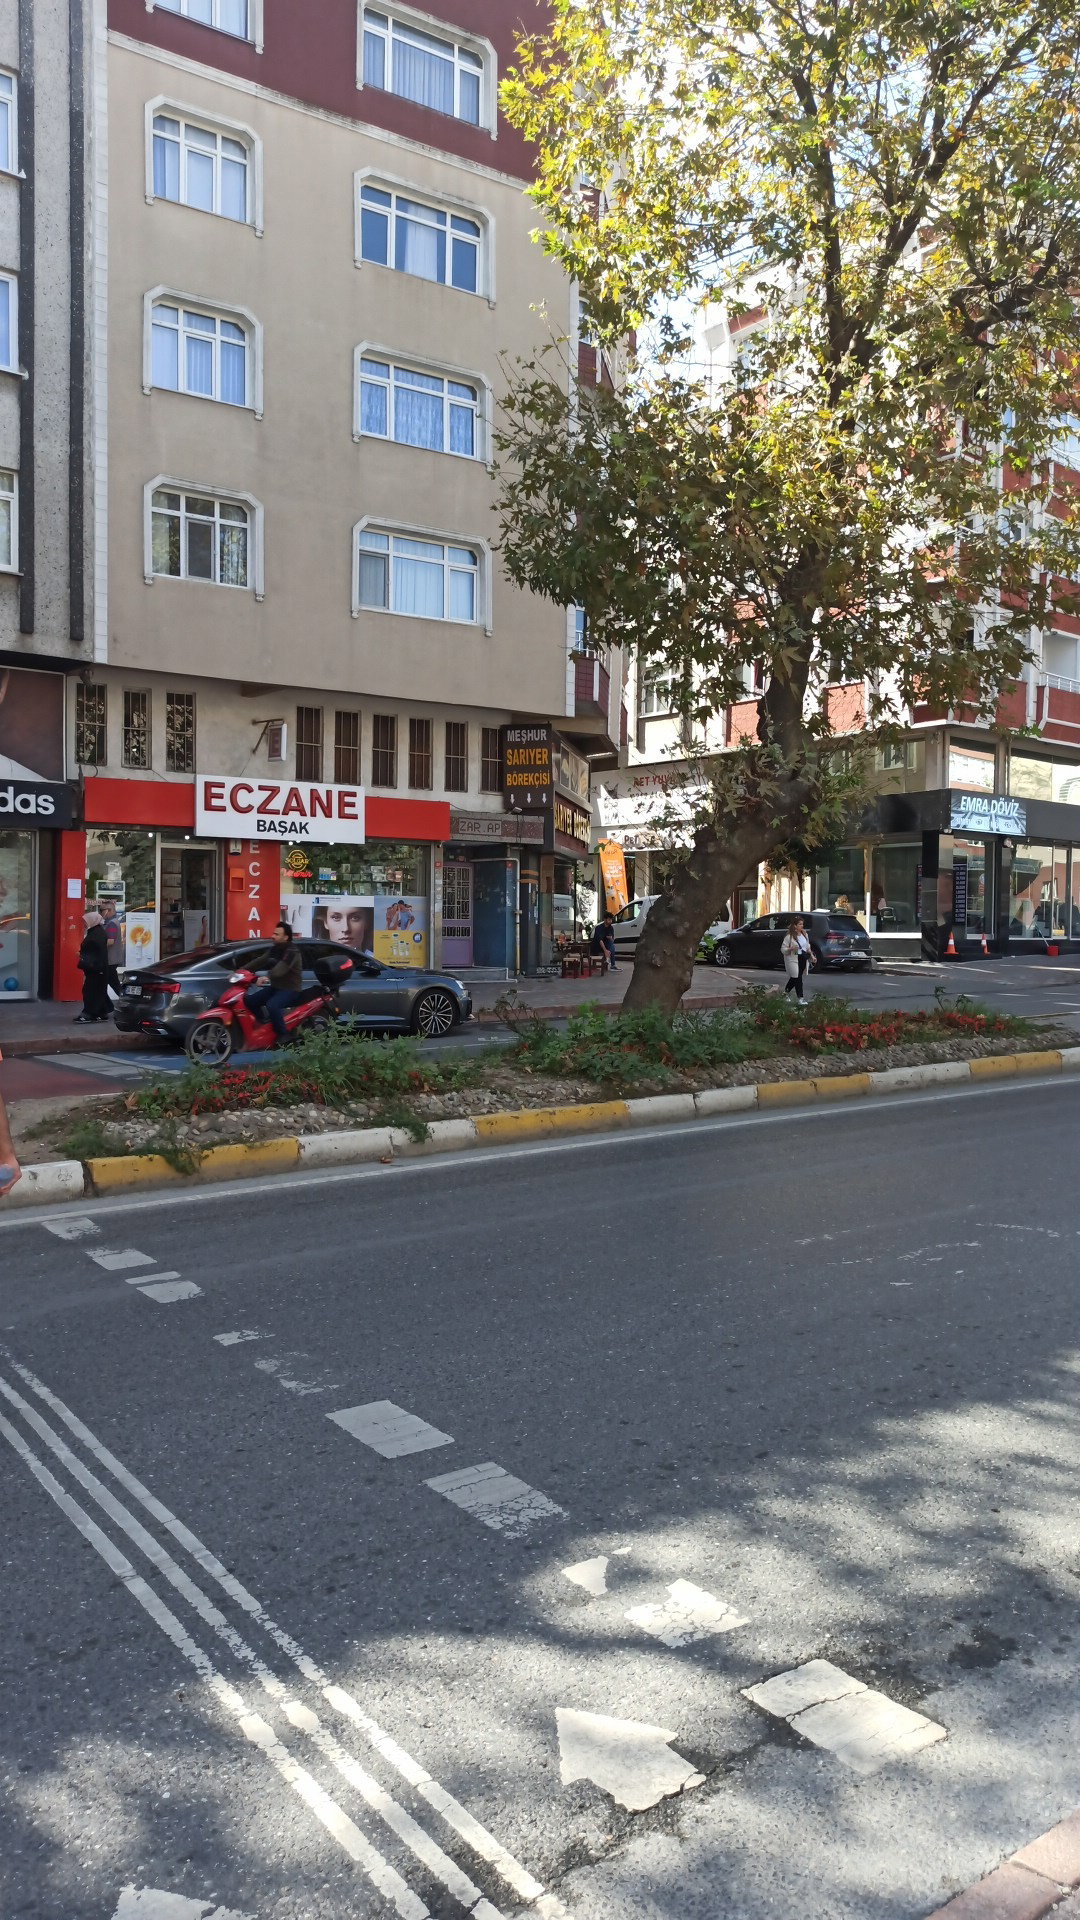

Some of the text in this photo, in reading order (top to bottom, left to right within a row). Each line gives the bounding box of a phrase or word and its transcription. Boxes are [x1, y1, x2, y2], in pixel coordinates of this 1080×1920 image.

[507, 729, 547, 744] MEŞHUR
[506, 748, 549, 766] SARIYER
[506, 770, 550, 788] BÖREKÇİSİ
[203, 780, 359, 820] ECZANE
[960, 796, 1019, 817] EMRA DÖVİZ
[256, 820, 309, 836] BAŞAK
